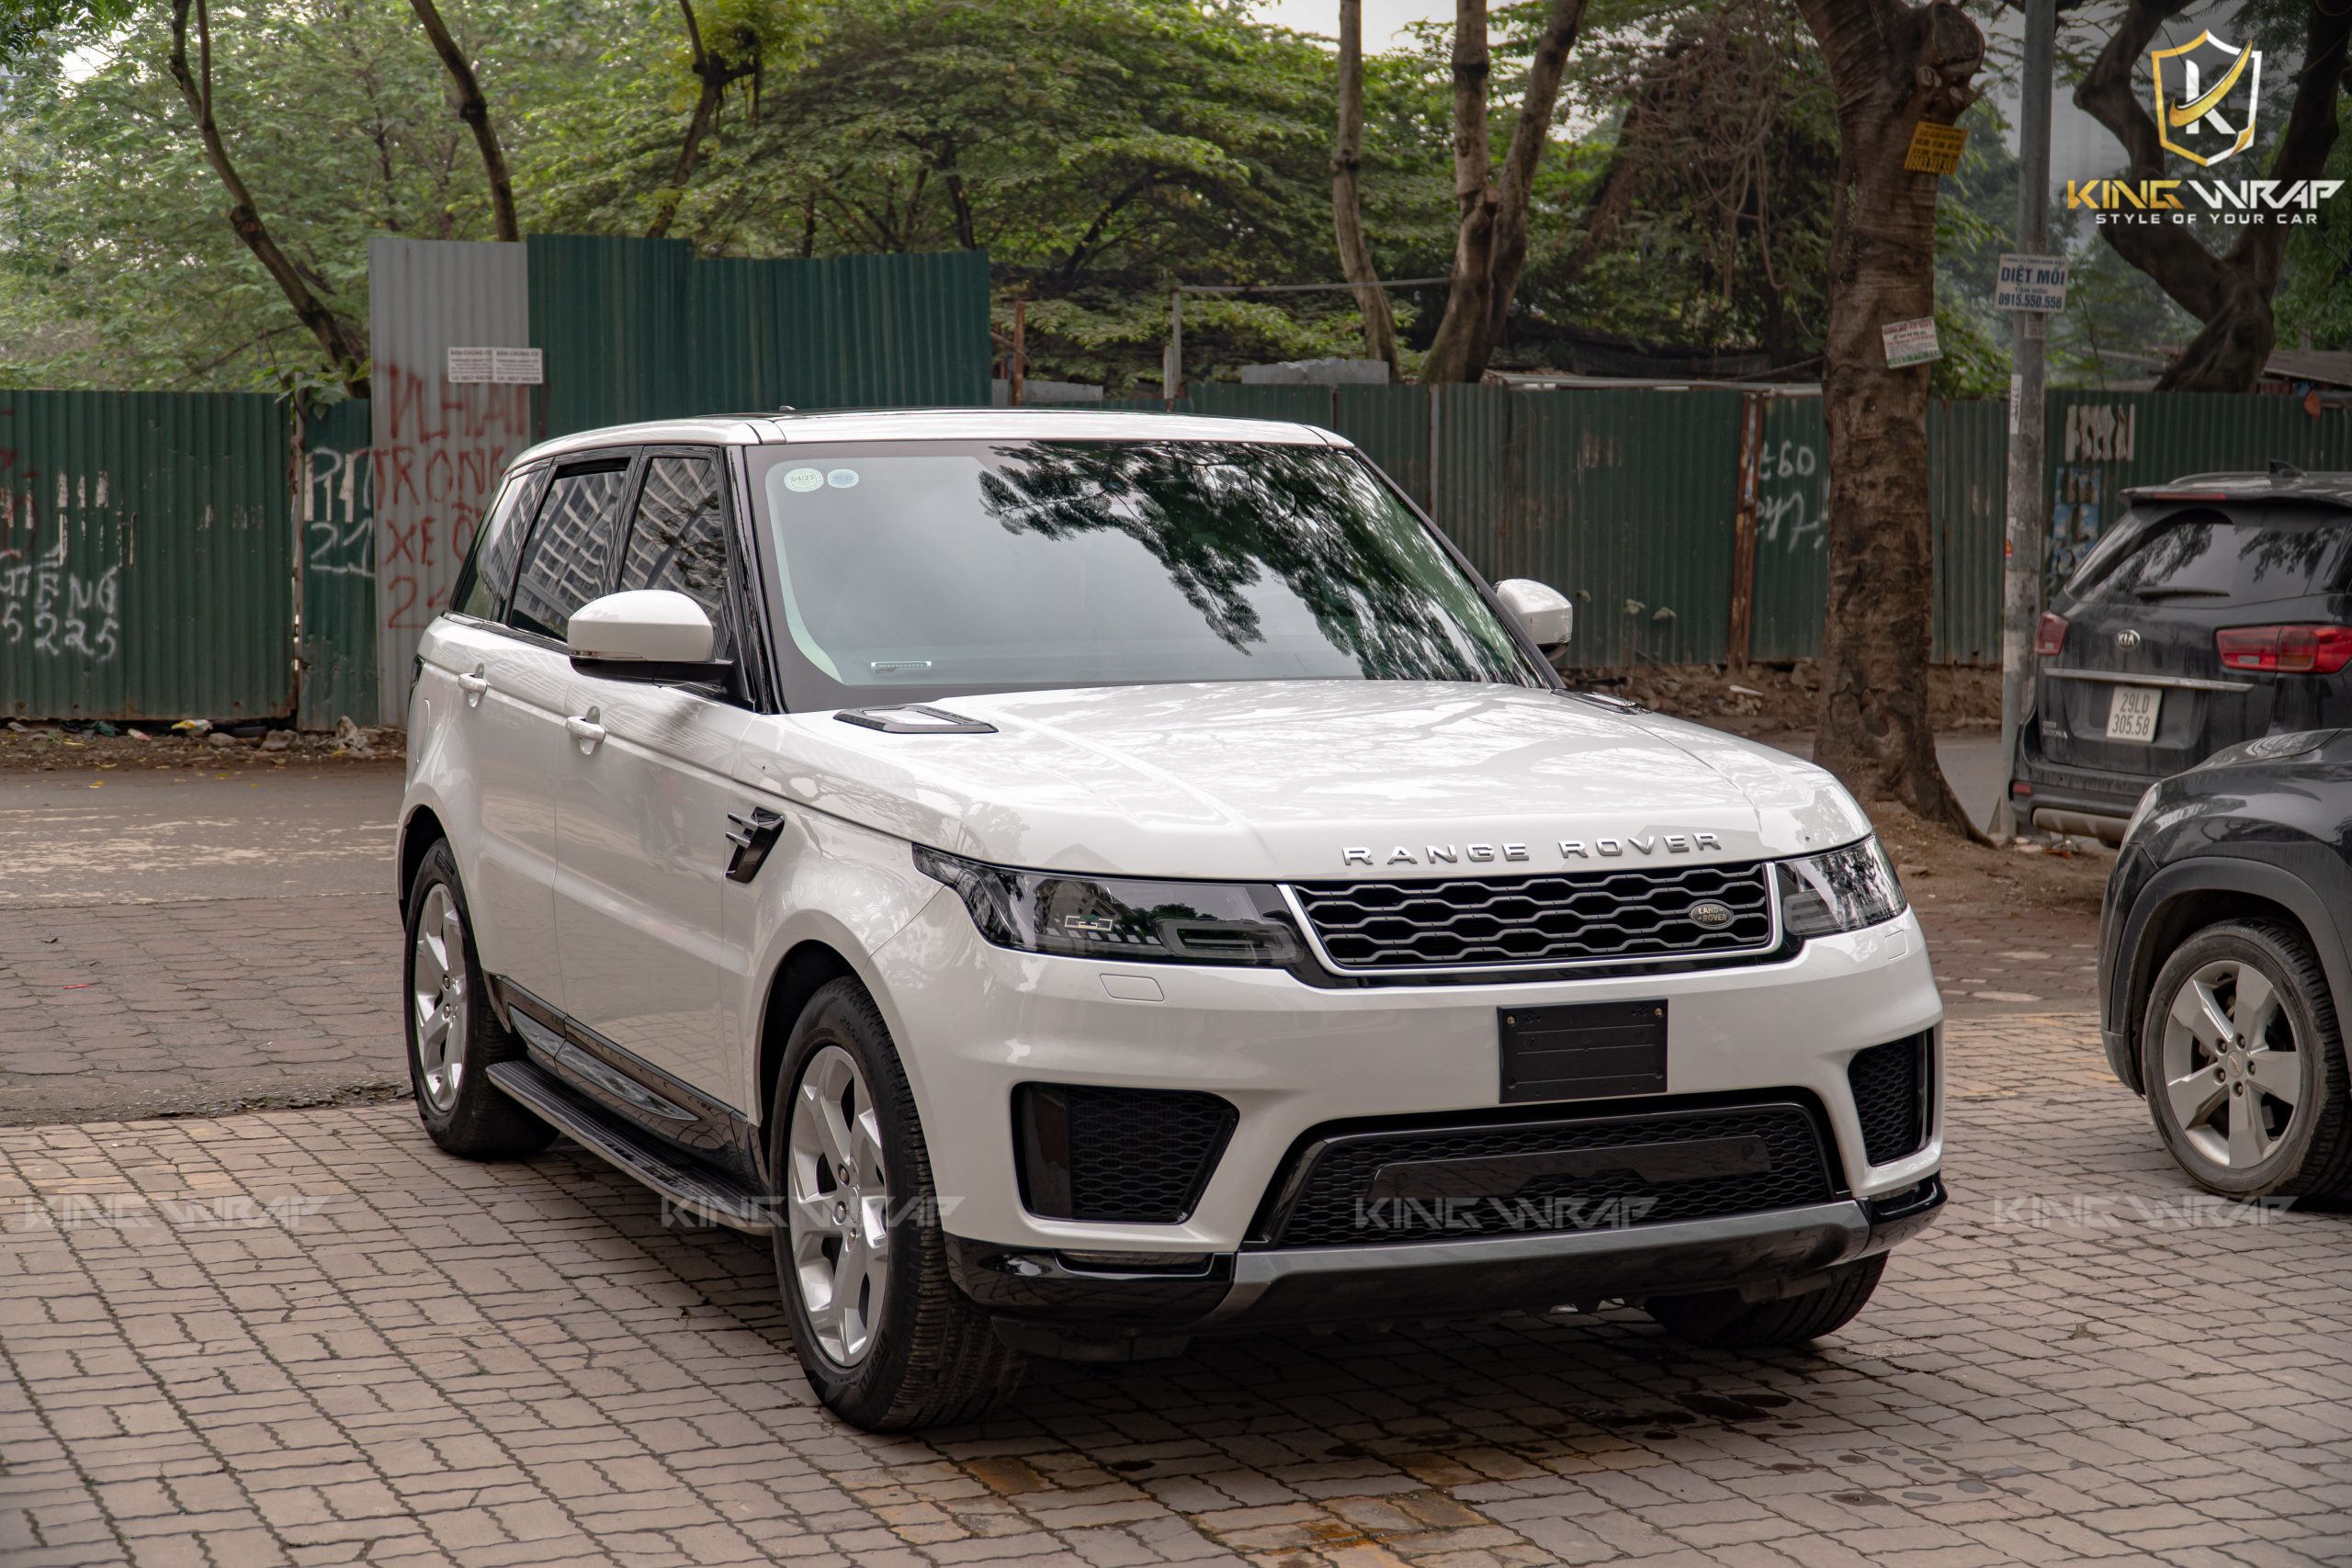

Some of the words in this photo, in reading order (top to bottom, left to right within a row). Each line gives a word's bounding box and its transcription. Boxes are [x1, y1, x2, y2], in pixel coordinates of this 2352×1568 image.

[2118, 633, 2135, 646] KIA
[2120, 693, 2151, 714] 29LD
[2111, 714, 2151, 736] 305.58
[1341, 841, 1530, 865] RANGE
[1557, 831, 1722, 860] ROVER
[1697, 907, 1719, 915] LAND
[1702, 913, 1728, 923] ROVER
